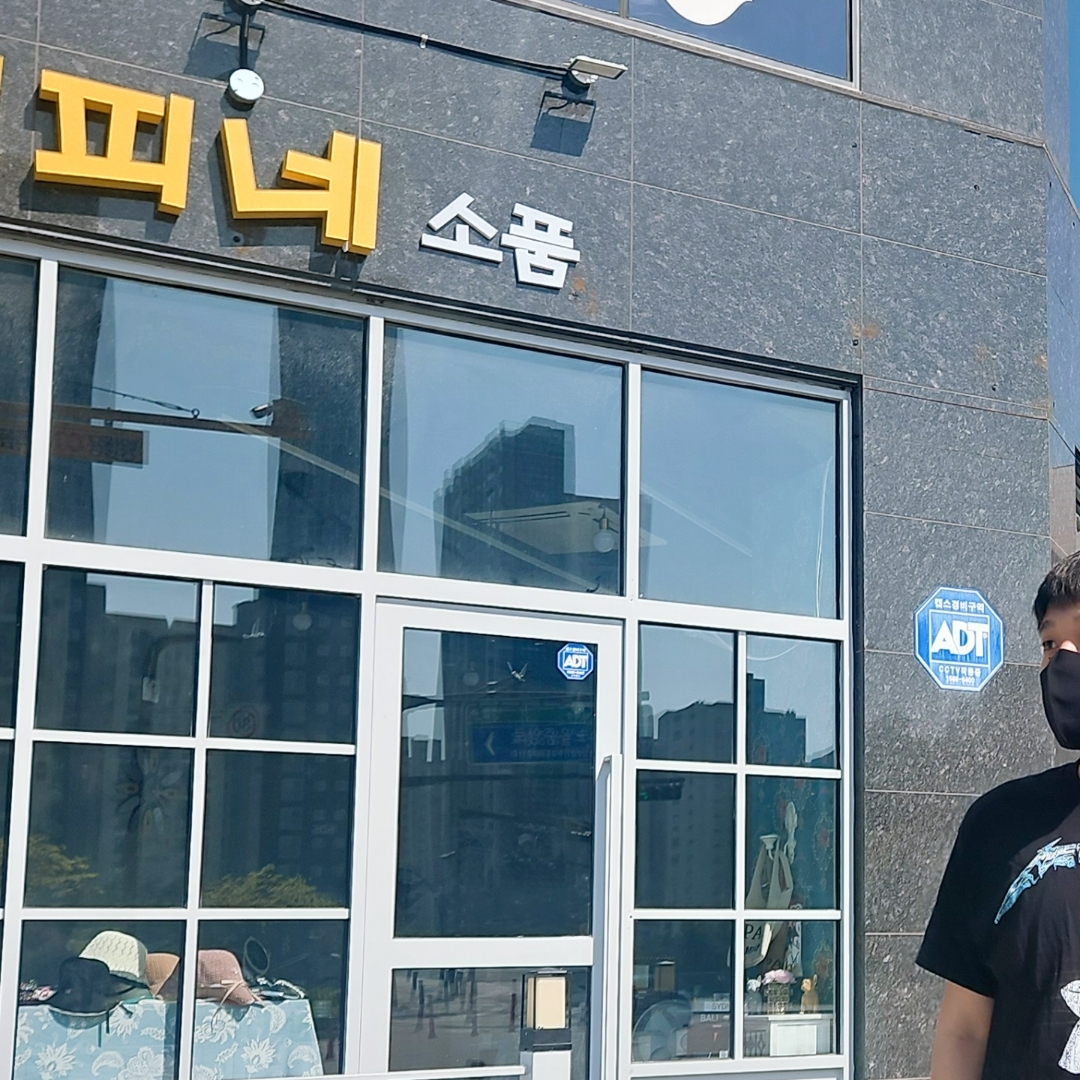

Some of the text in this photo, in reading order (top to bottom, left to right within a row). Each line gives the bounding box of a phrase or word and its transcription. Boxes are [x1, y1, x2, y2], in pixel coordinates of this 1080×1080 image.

[0, 55, 581, 291] 피네 소품
[931, 619, 989, 657] ADT
[564, 654, 587, 669] ADT
[700, 1014, 719, 1022] BALI
